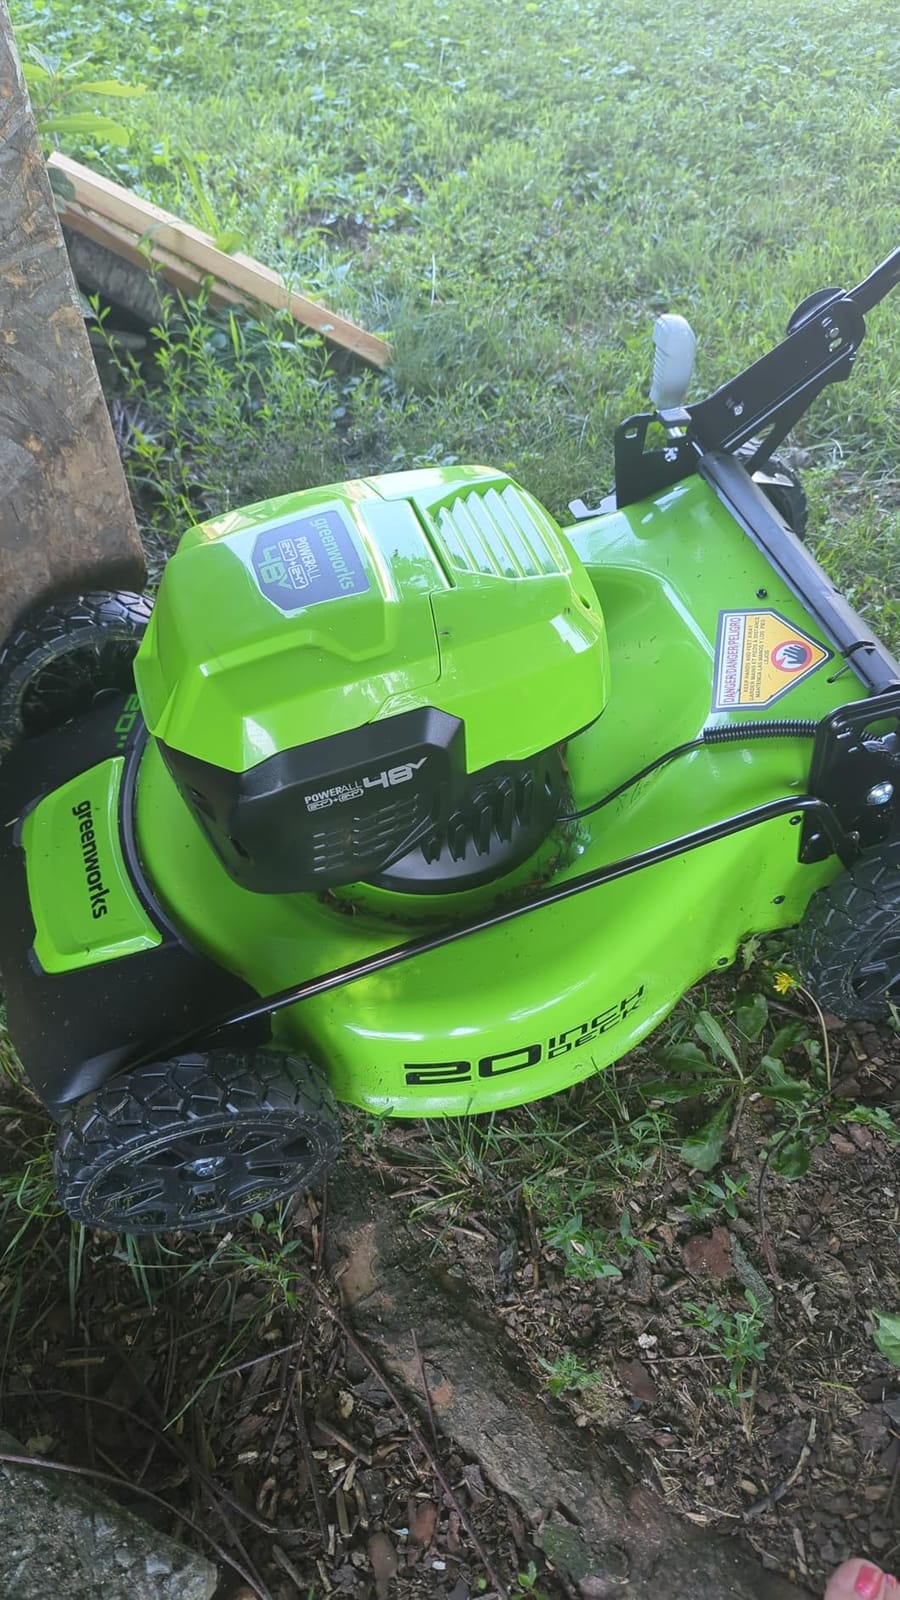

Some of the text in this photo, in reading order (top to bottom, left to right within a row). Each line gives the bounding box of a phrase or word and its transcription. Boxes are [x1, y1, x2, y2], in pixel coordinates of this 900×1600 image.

[258, 545, 293, 590] 48V
[294, 536, 321, 583] POWERALL
[309, 518, 355, 590] greenworks
[304, 757, 427, 804] POWERALL 48V
[72, 800, 110, 919] greenworks
[403, 1044, 542, 1085] 20
